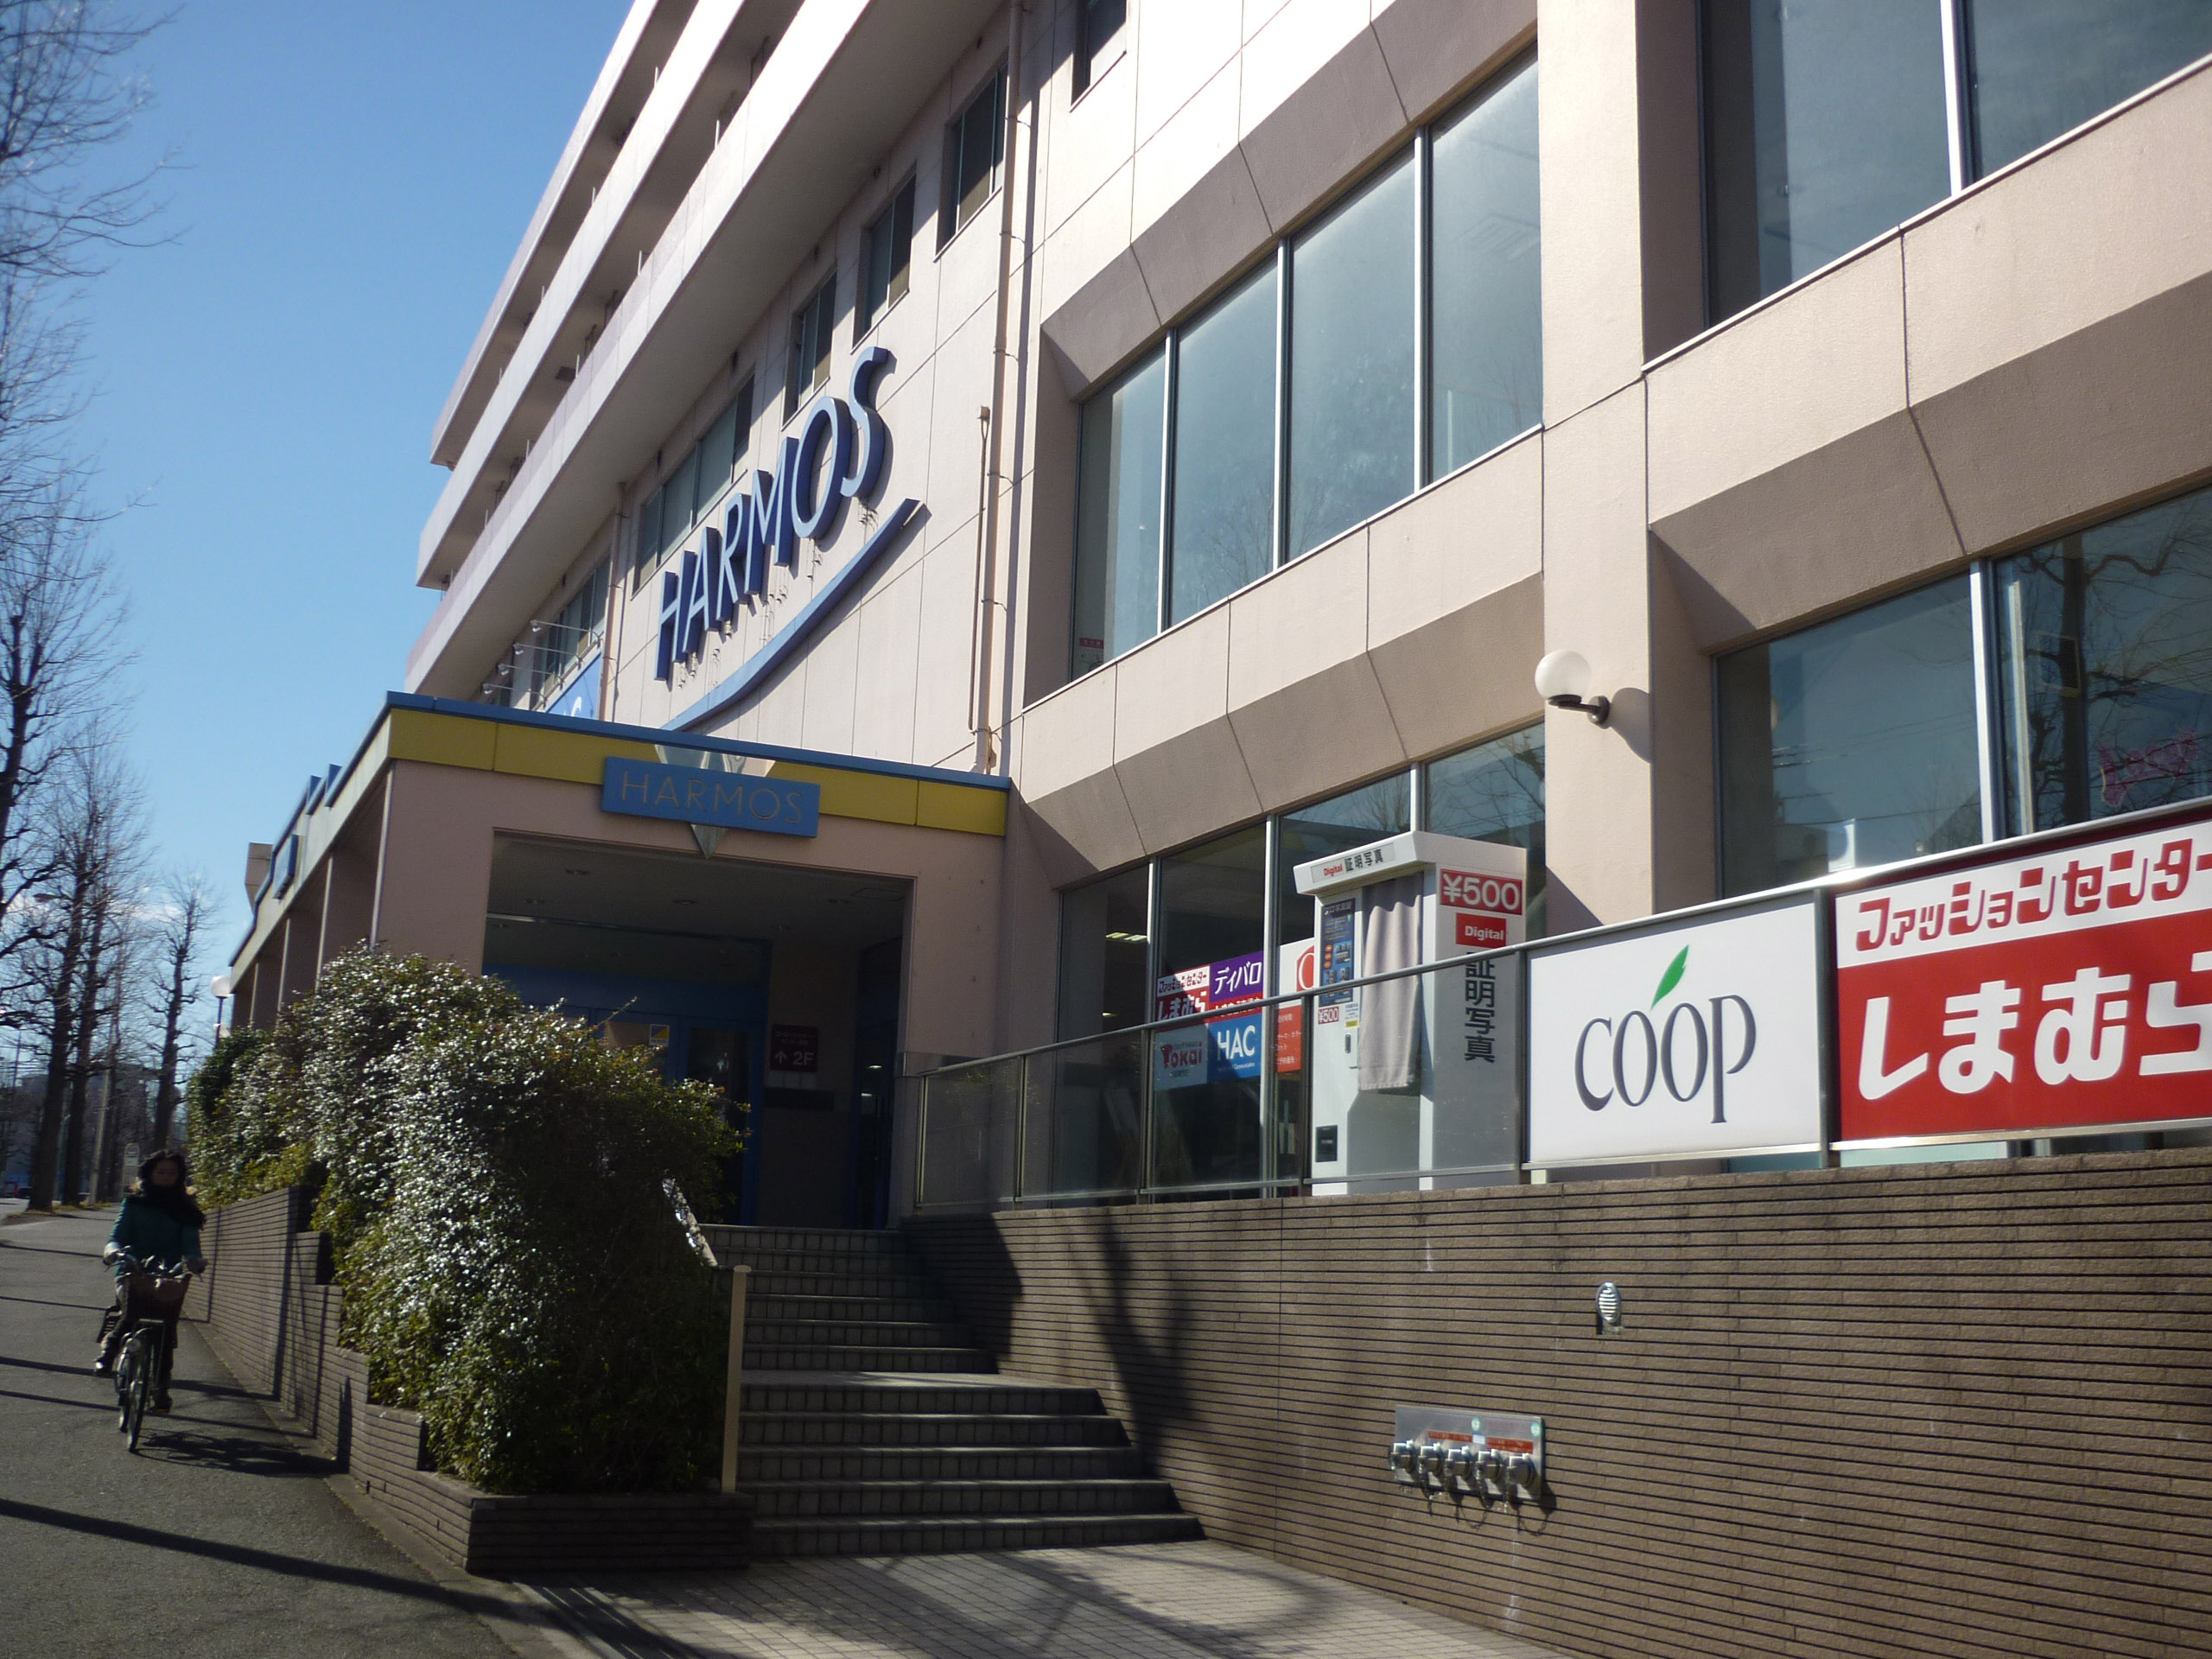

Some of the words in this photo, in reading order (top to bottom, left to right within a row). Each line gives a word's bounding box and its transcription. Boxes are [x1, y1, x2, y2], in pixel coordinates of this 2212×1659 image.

[654, 346, 890, 681] HARMOS
[621, 770, 803, 823] HARMOS
[1323, 864, 1343, 877] Digital
[1344, 849, 1383, 872] 証明写真
[1443, 873, 1521, 911] ¥500
[1465, 925, 1504, 941] Digital
[1215, 961, 1262, 995] ディバロ
[1319, 1007, 1338, 1023] ¥500
[792, 1051, 815, 1066] 2F
[1217, 1025, 1255, 1061] HAC
